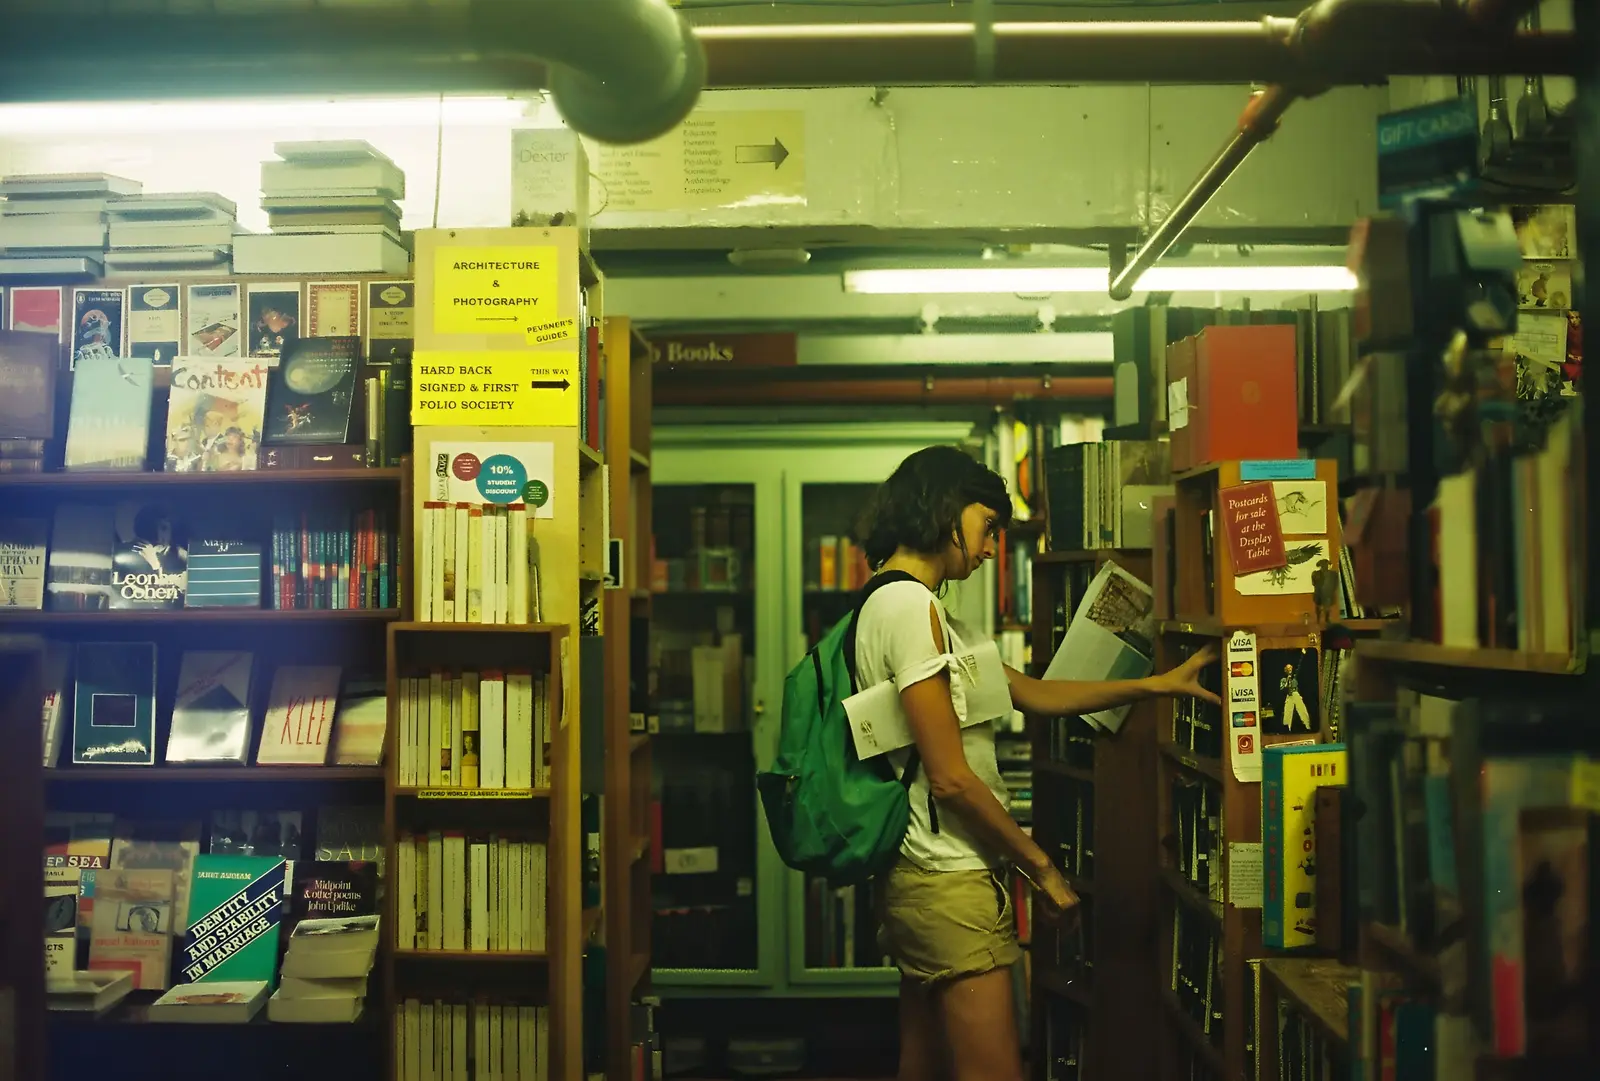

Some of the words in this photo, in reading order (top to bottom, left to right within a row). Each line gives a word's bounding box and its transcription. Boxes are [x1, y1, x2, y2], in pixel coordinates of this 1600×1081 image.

[1380, 121, 1414, 145] GIFT
[520, 149, 569, 163] Dexter
[453, 261, 540, 270] ARCHITECTURE
[492, 279, 500, 288] &
[453, 297, 539, 306] PHOTOGRAPHY
[526, 318, 573, 334] PEVSNER'S
[536, 330, 568, 343] GUIDES
[668, 341, 734, 362] Books
[171, 364, 268, 390] Content
[420, 366, 455, 375] HARD
[459, 366, 493, 375] BACK
[420, 383, 466, 392] SIGNED
[470, 383, 479, 392] &
[483, 383, 519, 392] FIRST
[420, 401, 457, 410] FOLIO
[461, 401, 515, 410] SOCIETY
[489, 465, 514, 475] 10%
[1228, 493, 1269, 510] Postcards
[1235, 510, 1249, 523] for
[1250, 508, 1266, 519] sale
[1241, 524, 1250, 534] at
[1252, 521, 1266, 532] the
[1240, 534, 1273, 548] Display
[1246, 547, 1270, 560] Table
[3, 565, 24, 575] MAN
[121, 584, 179, 600] Cohen
[1233, 638, 1252, 647] VISA
[1234, 687, 1254, 697] VISA
[280, 695, 328, 745] KLEE
[67, 856, 102, 868] SEA
[314, 879, 351, 892] Midpoint
[304, 889, 311, 898] &
[311, 890, 332, 899] other
[333, 891, 362, 902] poems
[308, 900, 327, 912] John
[328, 901, 357, 914] Updike
[190, 890, 250, 939] IDENTITY
[188, 935, 217, 961] AND
[217, 889, 278, 944] STABILITY
[185, 964, 204, 982] IN
[205, 916, 271, 970] MARRIAGE
